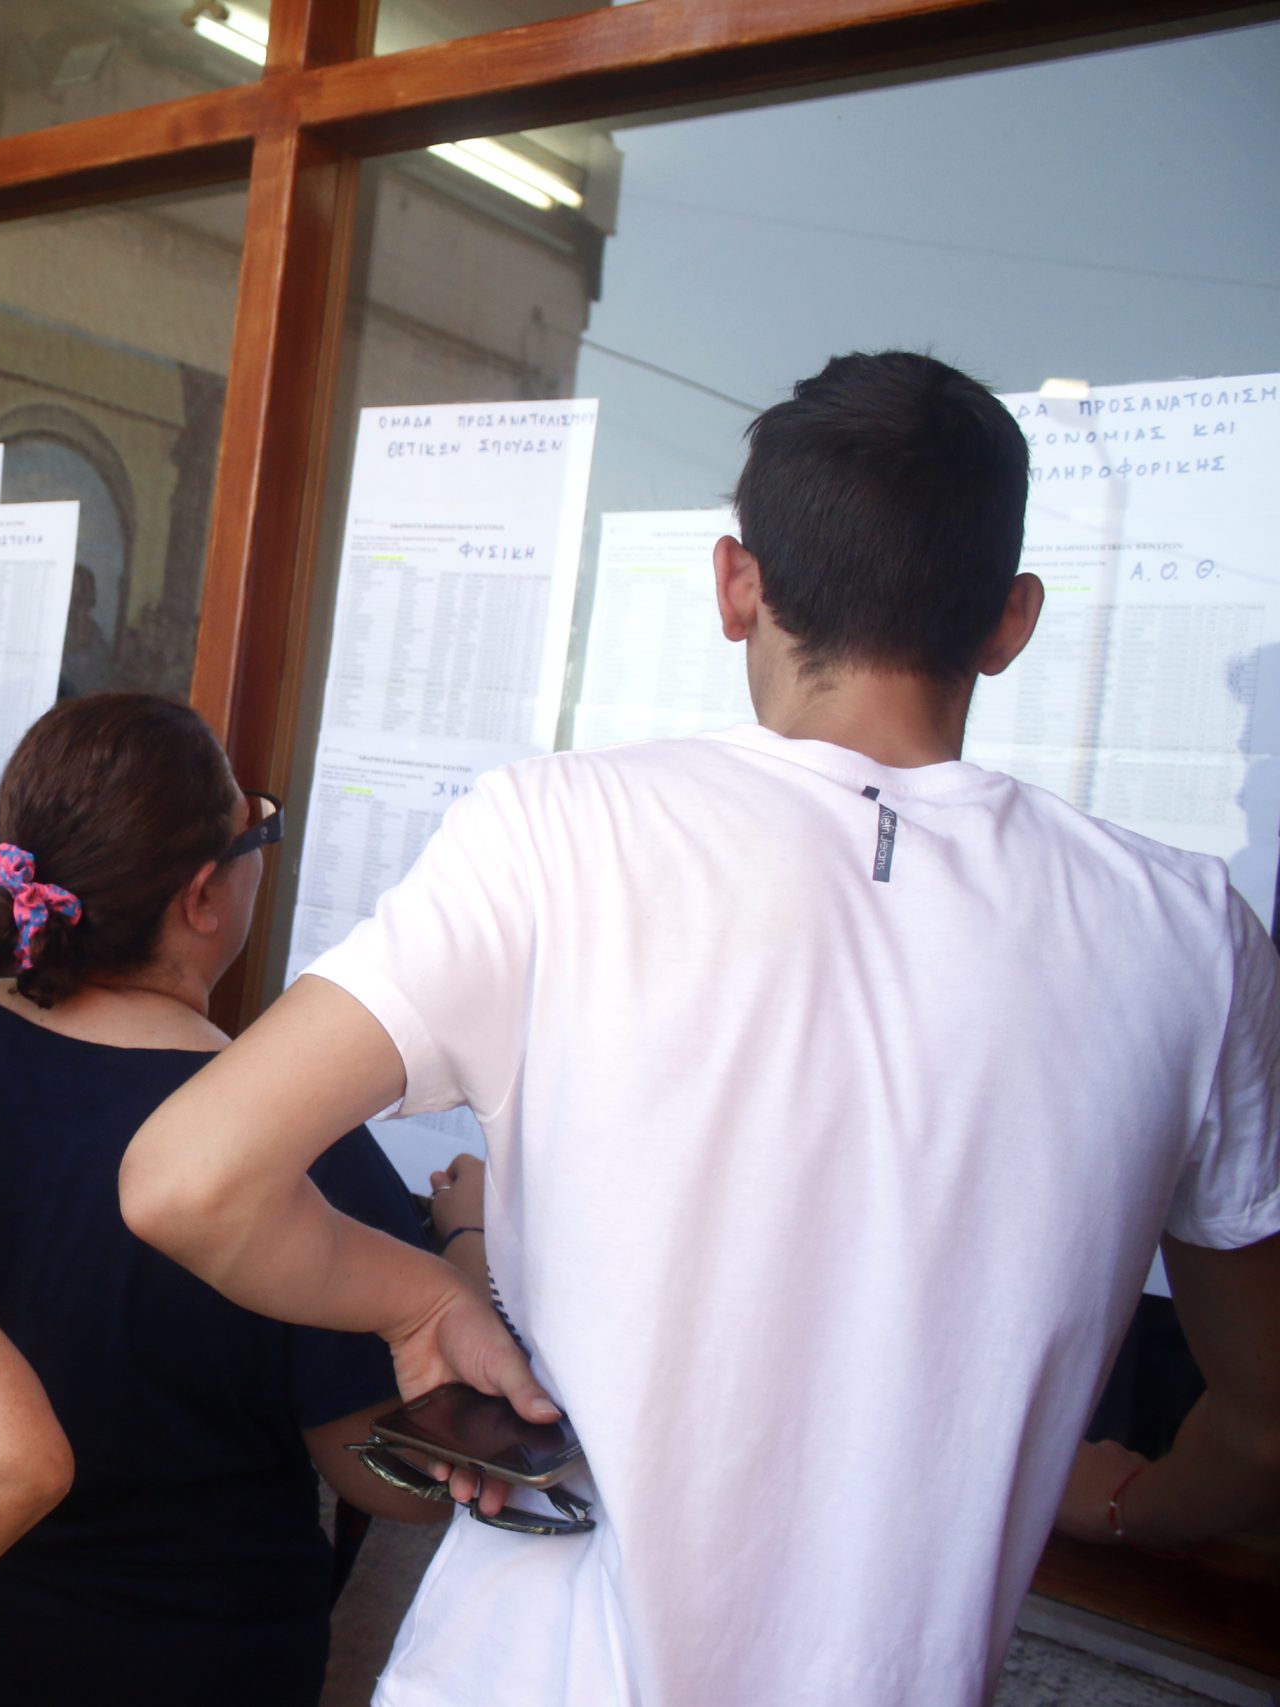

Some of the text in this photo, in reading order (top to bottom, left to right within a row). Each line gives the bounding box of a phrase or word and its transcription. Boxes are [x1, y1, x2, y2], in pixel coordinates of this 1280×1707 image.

[378, 415, 433, 429] ΟΜΑΔΑ
[1193, 421, 1236, 437] ΚΑΙ
[1030, 455, 1226, 482] ΠΛΗΡΟΦΟΡΙΚΗΣ
[458, 541, 536, 560] ΦΥΣΙΚΗ
[876, 835, 892, 870] Jeans
